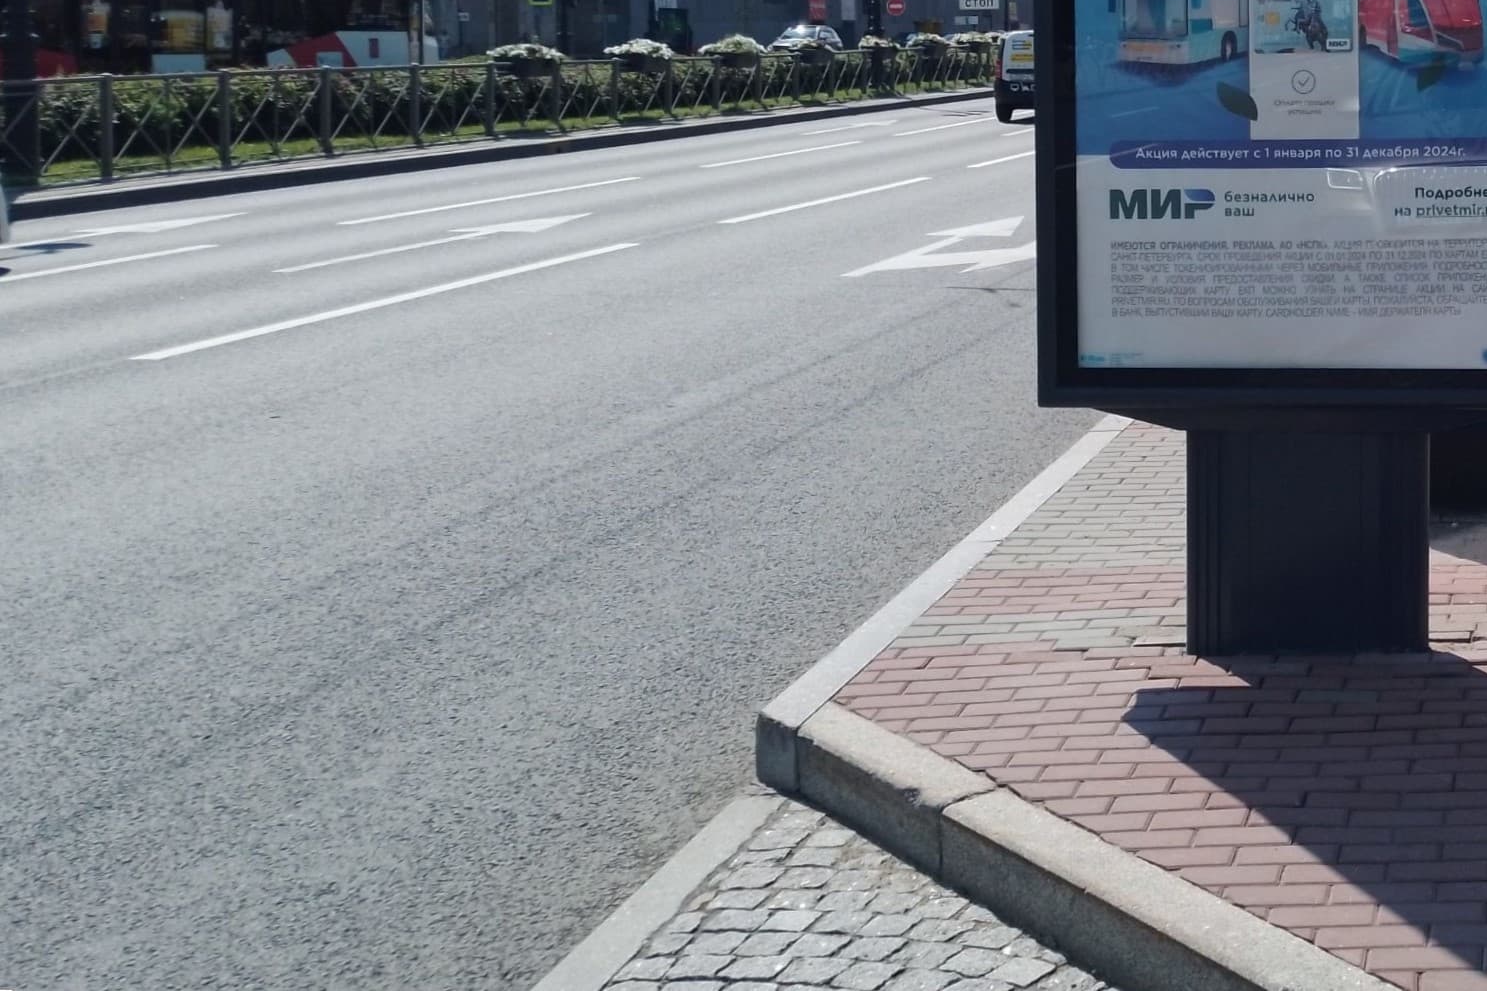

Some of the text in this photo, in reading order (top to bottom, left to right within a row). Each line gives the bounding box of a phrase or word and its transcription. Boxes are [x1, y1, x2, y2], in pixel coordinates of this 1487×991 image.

[1135, 148, 1178, 160] Акция
[1181, 147, 1249, 160] действует
[1253, 149, 1261, 158] с
[1264, 147, 1270, 158] 1
[1274, 149, 1321, 160] января
[1325, 149, 1343, 158] по
[1346, 147, 1360, 158] 31
[1363, 147, 1420, 159] декабря
[1224, 191, 1315, 203] безналично
[1110, 189, 1216, 220] МИР
[1224, 207, 1255, 217] ваш
[1395, 208, 1411, 216] на
